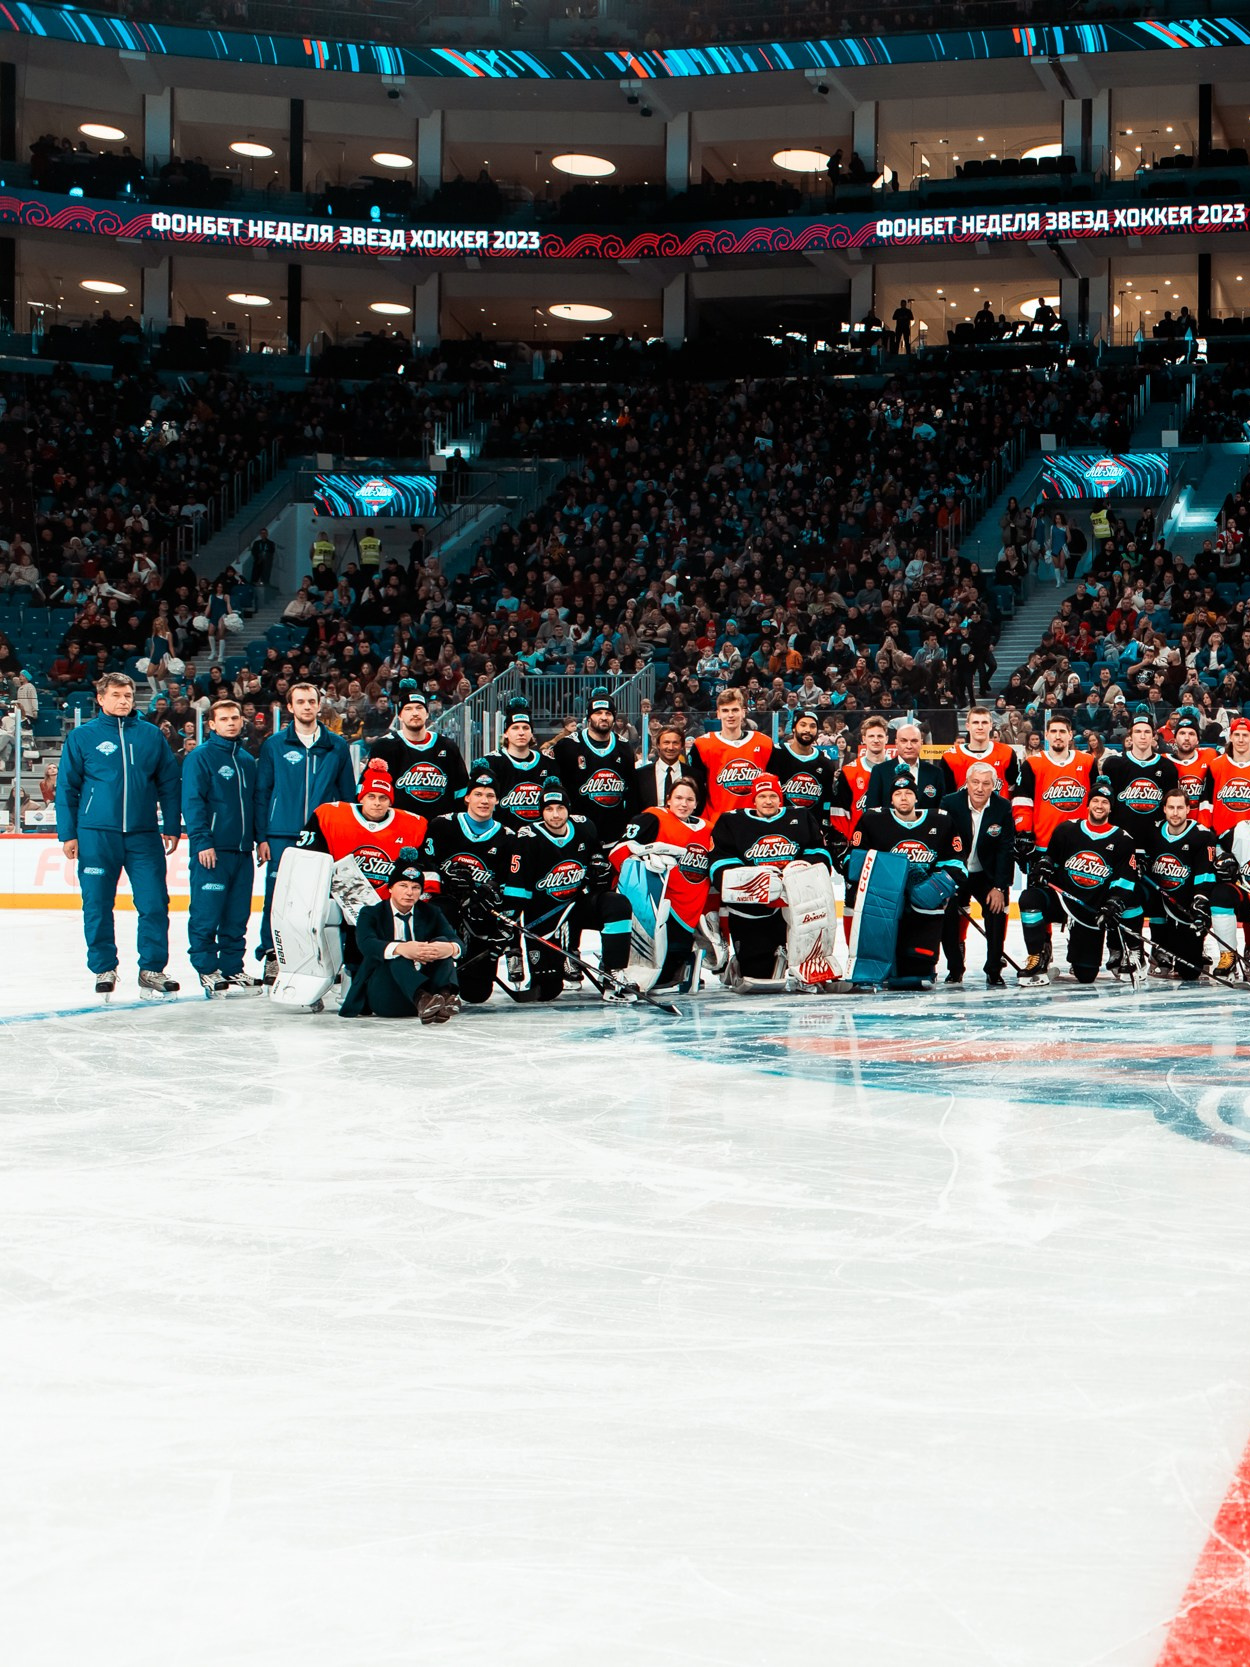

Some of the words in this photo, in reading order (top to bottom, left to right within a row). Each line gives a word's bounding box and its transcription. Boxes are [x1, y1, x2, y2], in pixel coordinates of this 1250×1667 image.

[876, 216, 957, 238] ФОНБЕТ
[962, 212, 1039, 235] НЕДЕЛЯ
[1046, 210, 1109, 231] ЗВЕЗД
[1114, 206, 1192, 227] ХОККЕЯ
[1198, 204, 1245, 223] 2023
[152, 212, 243, 236] ФОНБЕТ
[249, 220, 333, 243] НЕДЕЛЯ
[339, 226, 406, 250] ЗВЕЗД
[410, 230, 488, 248] ХОККЕЯ
[493, 231, 540, 249] 2023
[1086, 466, 1124, 477] All-Star
[396, 772, 447, 787] All-Star
[718, 768, 762, 783] All-Star
[580, 778, 624, 792] All-Star
[782, 781, 822, 796] All-Star
[1043, 786, 1086, 799] All-Star
[502, 791, 540, 805] All-St
[1119, 786, 1163, 800] All-Star
[746, 843, 797, 858] All-Star
[354, 855, 395, 875] ll-Star
[458, 856, 478, 866] FONBET
[1064, 856, 1110, 878] All-Star
[859, 856, 873, 893] CCM
[1152, 860, 1189, 878] All-Star
[538, 868, 586, 889] All-Star
[274, 930, 286, 965] BAUER
